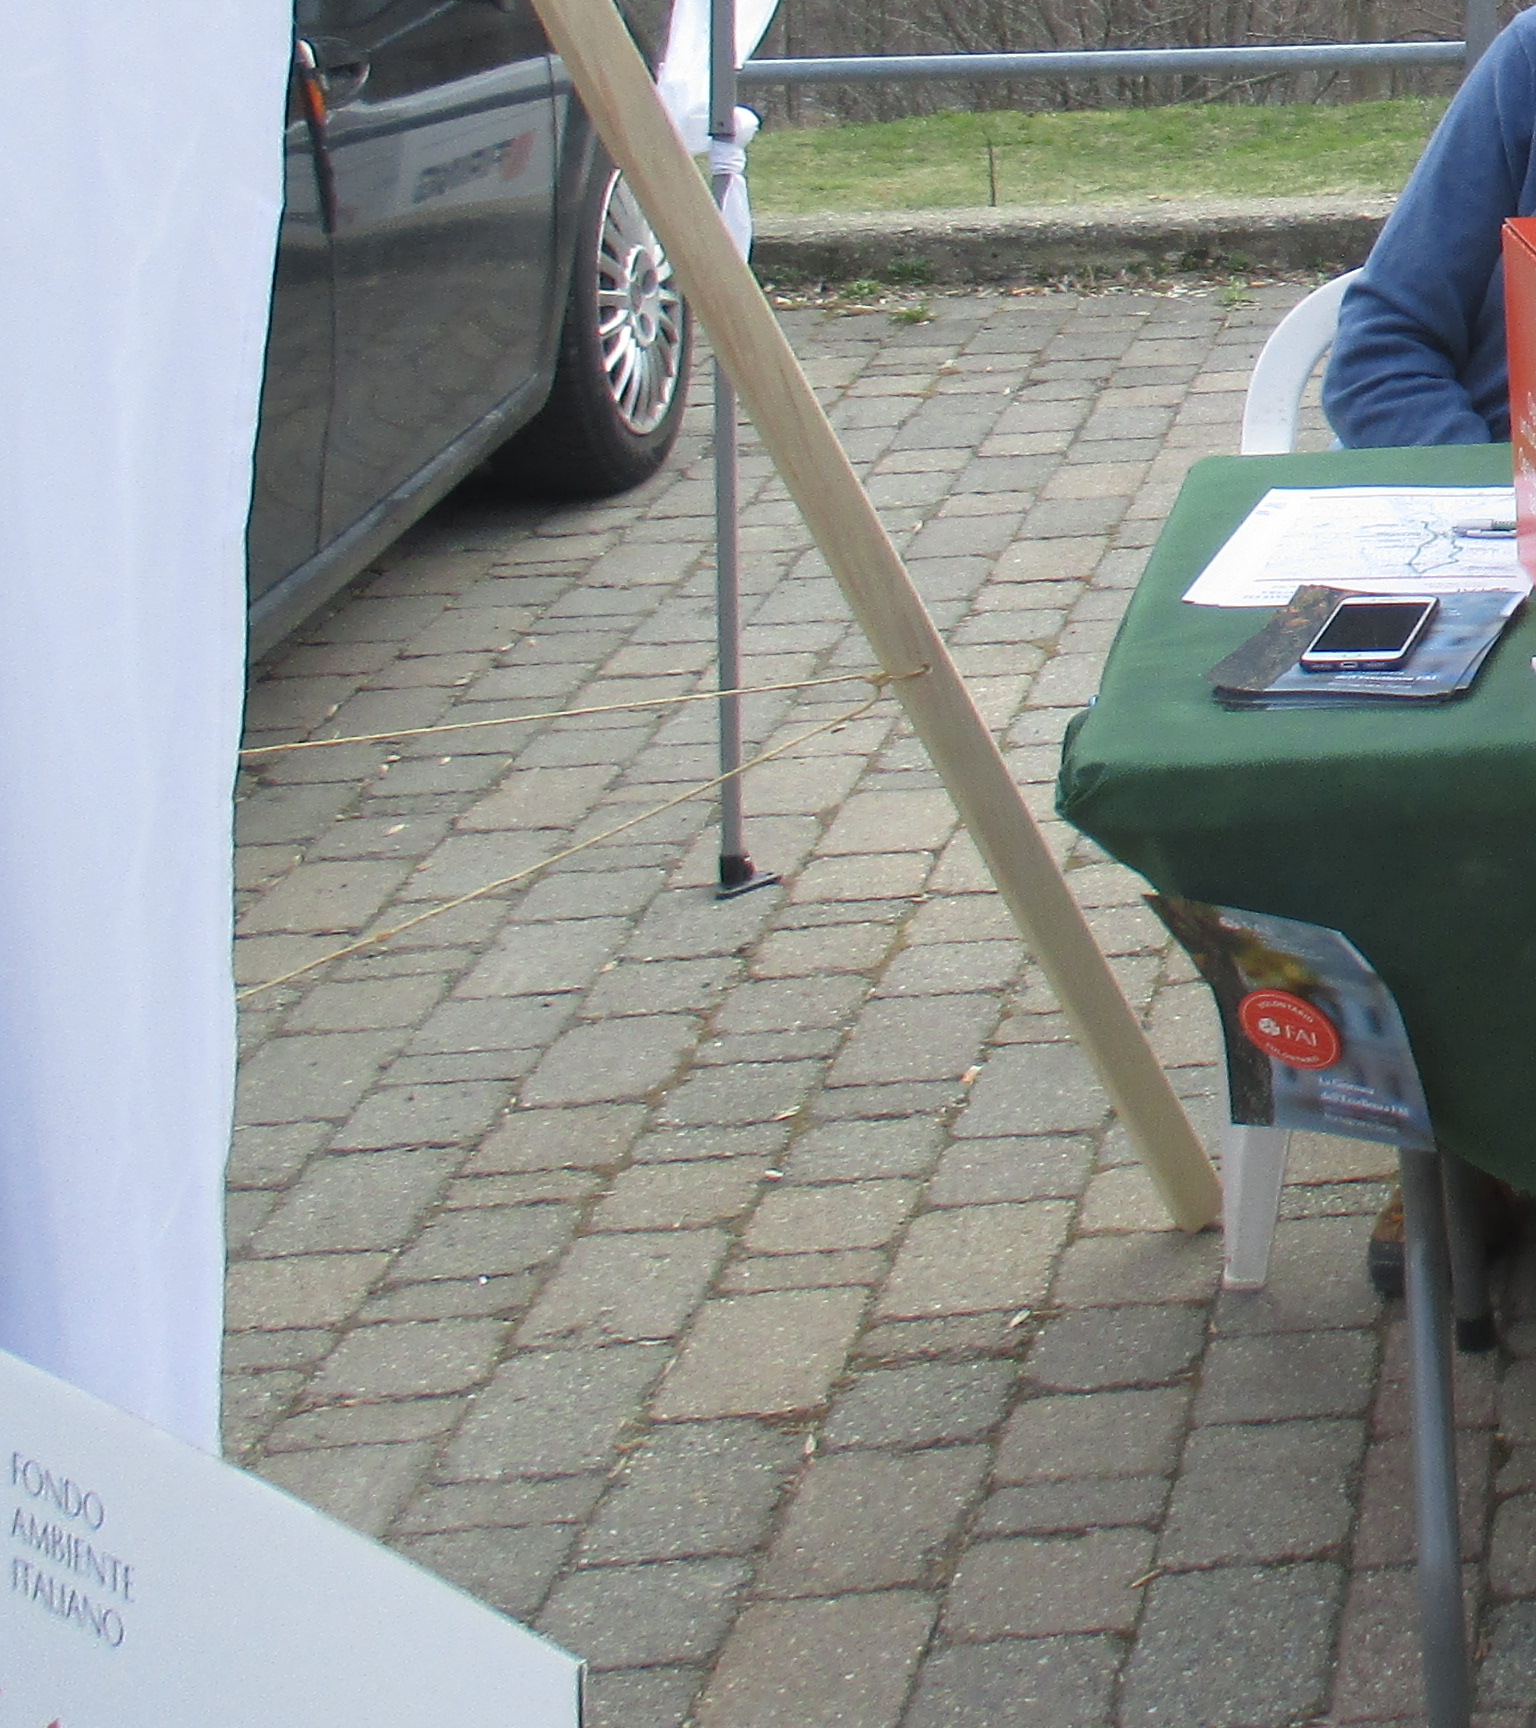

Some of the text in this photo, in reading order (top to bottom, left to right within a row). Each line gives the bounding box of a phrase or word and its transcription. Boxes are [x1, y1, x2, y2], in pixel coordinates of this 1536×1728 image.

[12, 1451, 105, 1531] FONDO
[12, 1506, 136, 1604] AMBIENTE
[13, 1555, 125, 1648] ITALIANO
